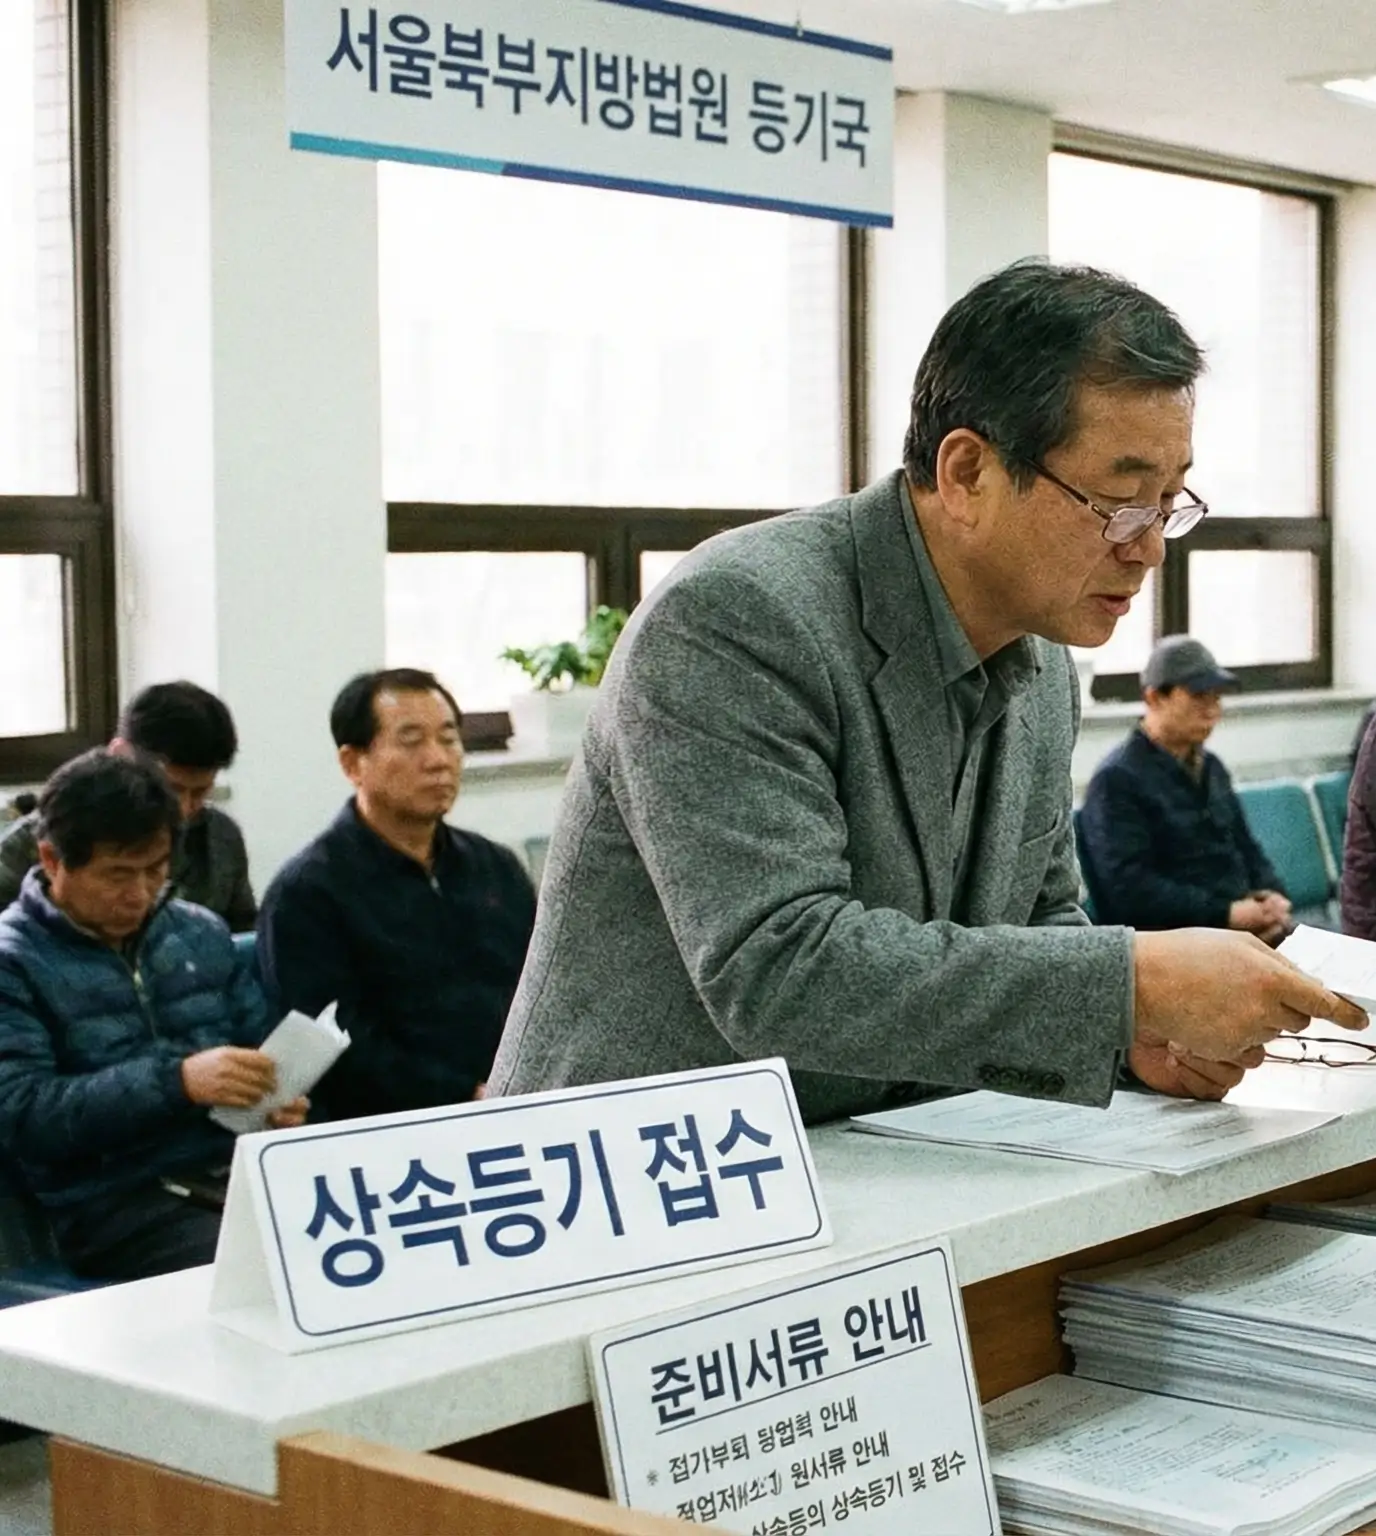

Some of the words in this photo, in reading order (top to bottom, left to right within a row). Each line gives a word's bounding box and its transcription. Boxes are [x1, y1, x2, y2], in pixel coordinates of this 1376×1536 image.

[327, 7, 729, 145] 서울북부지방법원
[749, 81, 870, 168] 등기국
[306, 1130, 625, 1288] 상속등기
[639, 1109, 784, 1227] 접수
[650, 1318, 829, 1425] 준비서류
[843, 1286, 927, 1362] 안내
[790, 1447, 847, 1489] 원서류
[852, 1430, 889, 1466] 안내
[820, 1396, 858, 1432] 안내
[832, 1471, 903, 1521] 상속등기
[931, 1450, 966, 1482] 접수
